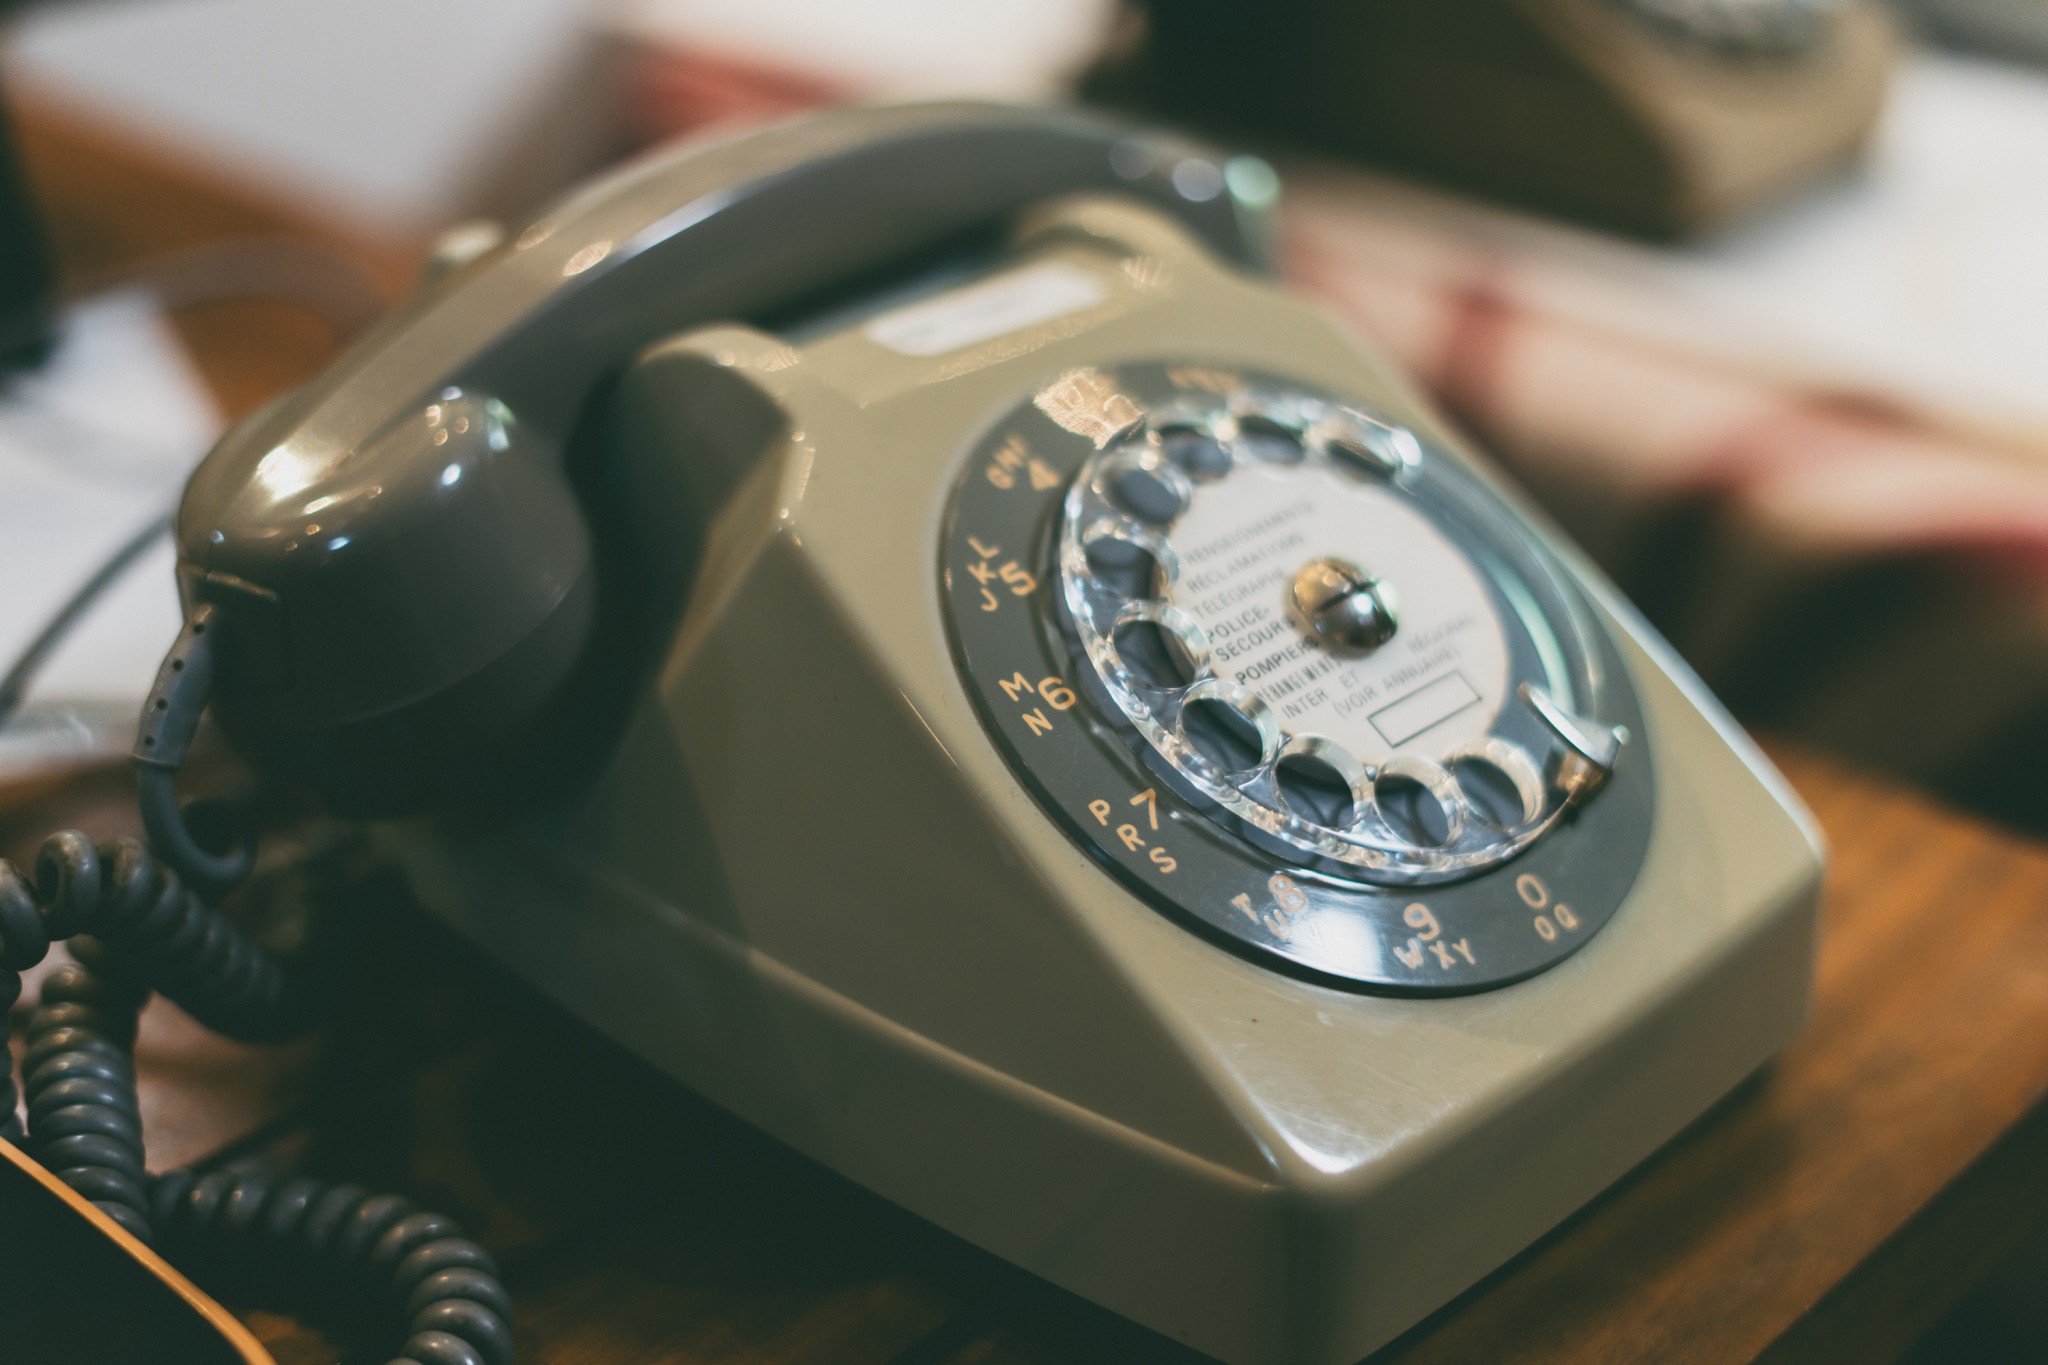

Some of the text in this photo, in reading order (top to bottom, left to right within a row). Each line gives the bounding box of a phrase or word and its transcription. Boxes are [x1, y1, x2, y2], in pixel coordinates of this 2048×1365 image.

[999, 561, 1037, 596] 5
[1038, 676, 1077, 711] 6
[1280, 687, 1329, 719] INTER
[1339, 668, 1360, 690] ET
[1129, 788, 1159, 831] 7
[1267, 872, 1308, 913] 8
[1402, 902, 1441, 942] 9
